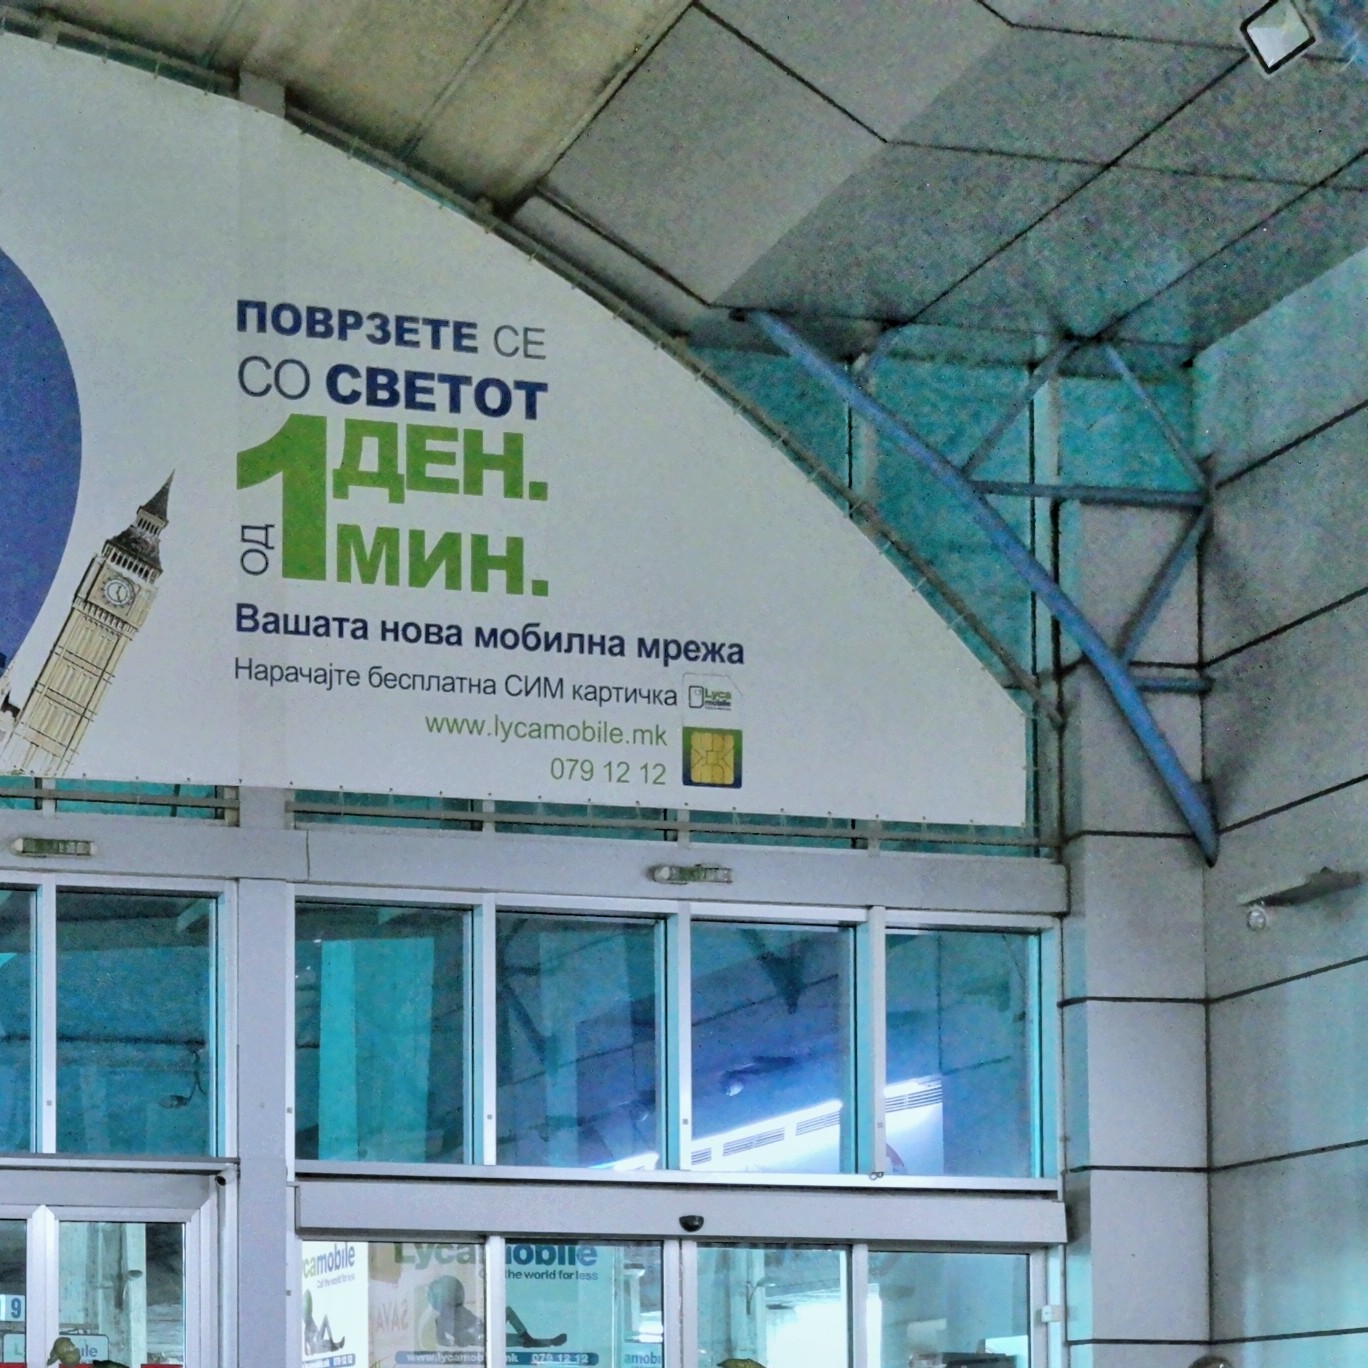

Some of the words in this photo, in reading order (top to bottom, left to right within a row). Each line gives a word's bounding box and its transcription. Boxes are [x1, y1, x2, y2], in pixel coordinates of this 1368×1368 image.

[237, 299, 478, 355] ПОВРЗЕТЕ
[493, 324, 546, 360] СЕ
[237, 356, 311, 400] СО
[325, 363, 548, 421] СВЕТОТ
[332, 417, 549, 504] ДЕН.
[236, 412, 327, 583] 1
[336, 523, 549, 597] МИН.
[235, 602, 370, 641] Вашата
[380, 620, 463, 647] нова
[475, 622, 626, 660] мобилна
[637, 634, 745, 667] мрежа
[234, 657, 361, 692] Нарачајте
[368, 665, 497, 697] бесплатна
[504, 673, 565, 700] СИМ
[572, 682, 678, 711] картичка
[425, 715, 668, 748] www.lycamobile.mk
[549, 757, 595, 782] 079
[602, 758, 631, 784] 12
[639, 761, 667, 786] 12
[524, 1269, 556, 1280] world
[558, 1270, 573, 1280] for
[575, 1270, 599, 1281] less
[10, 1297, 22, 1319] 9
